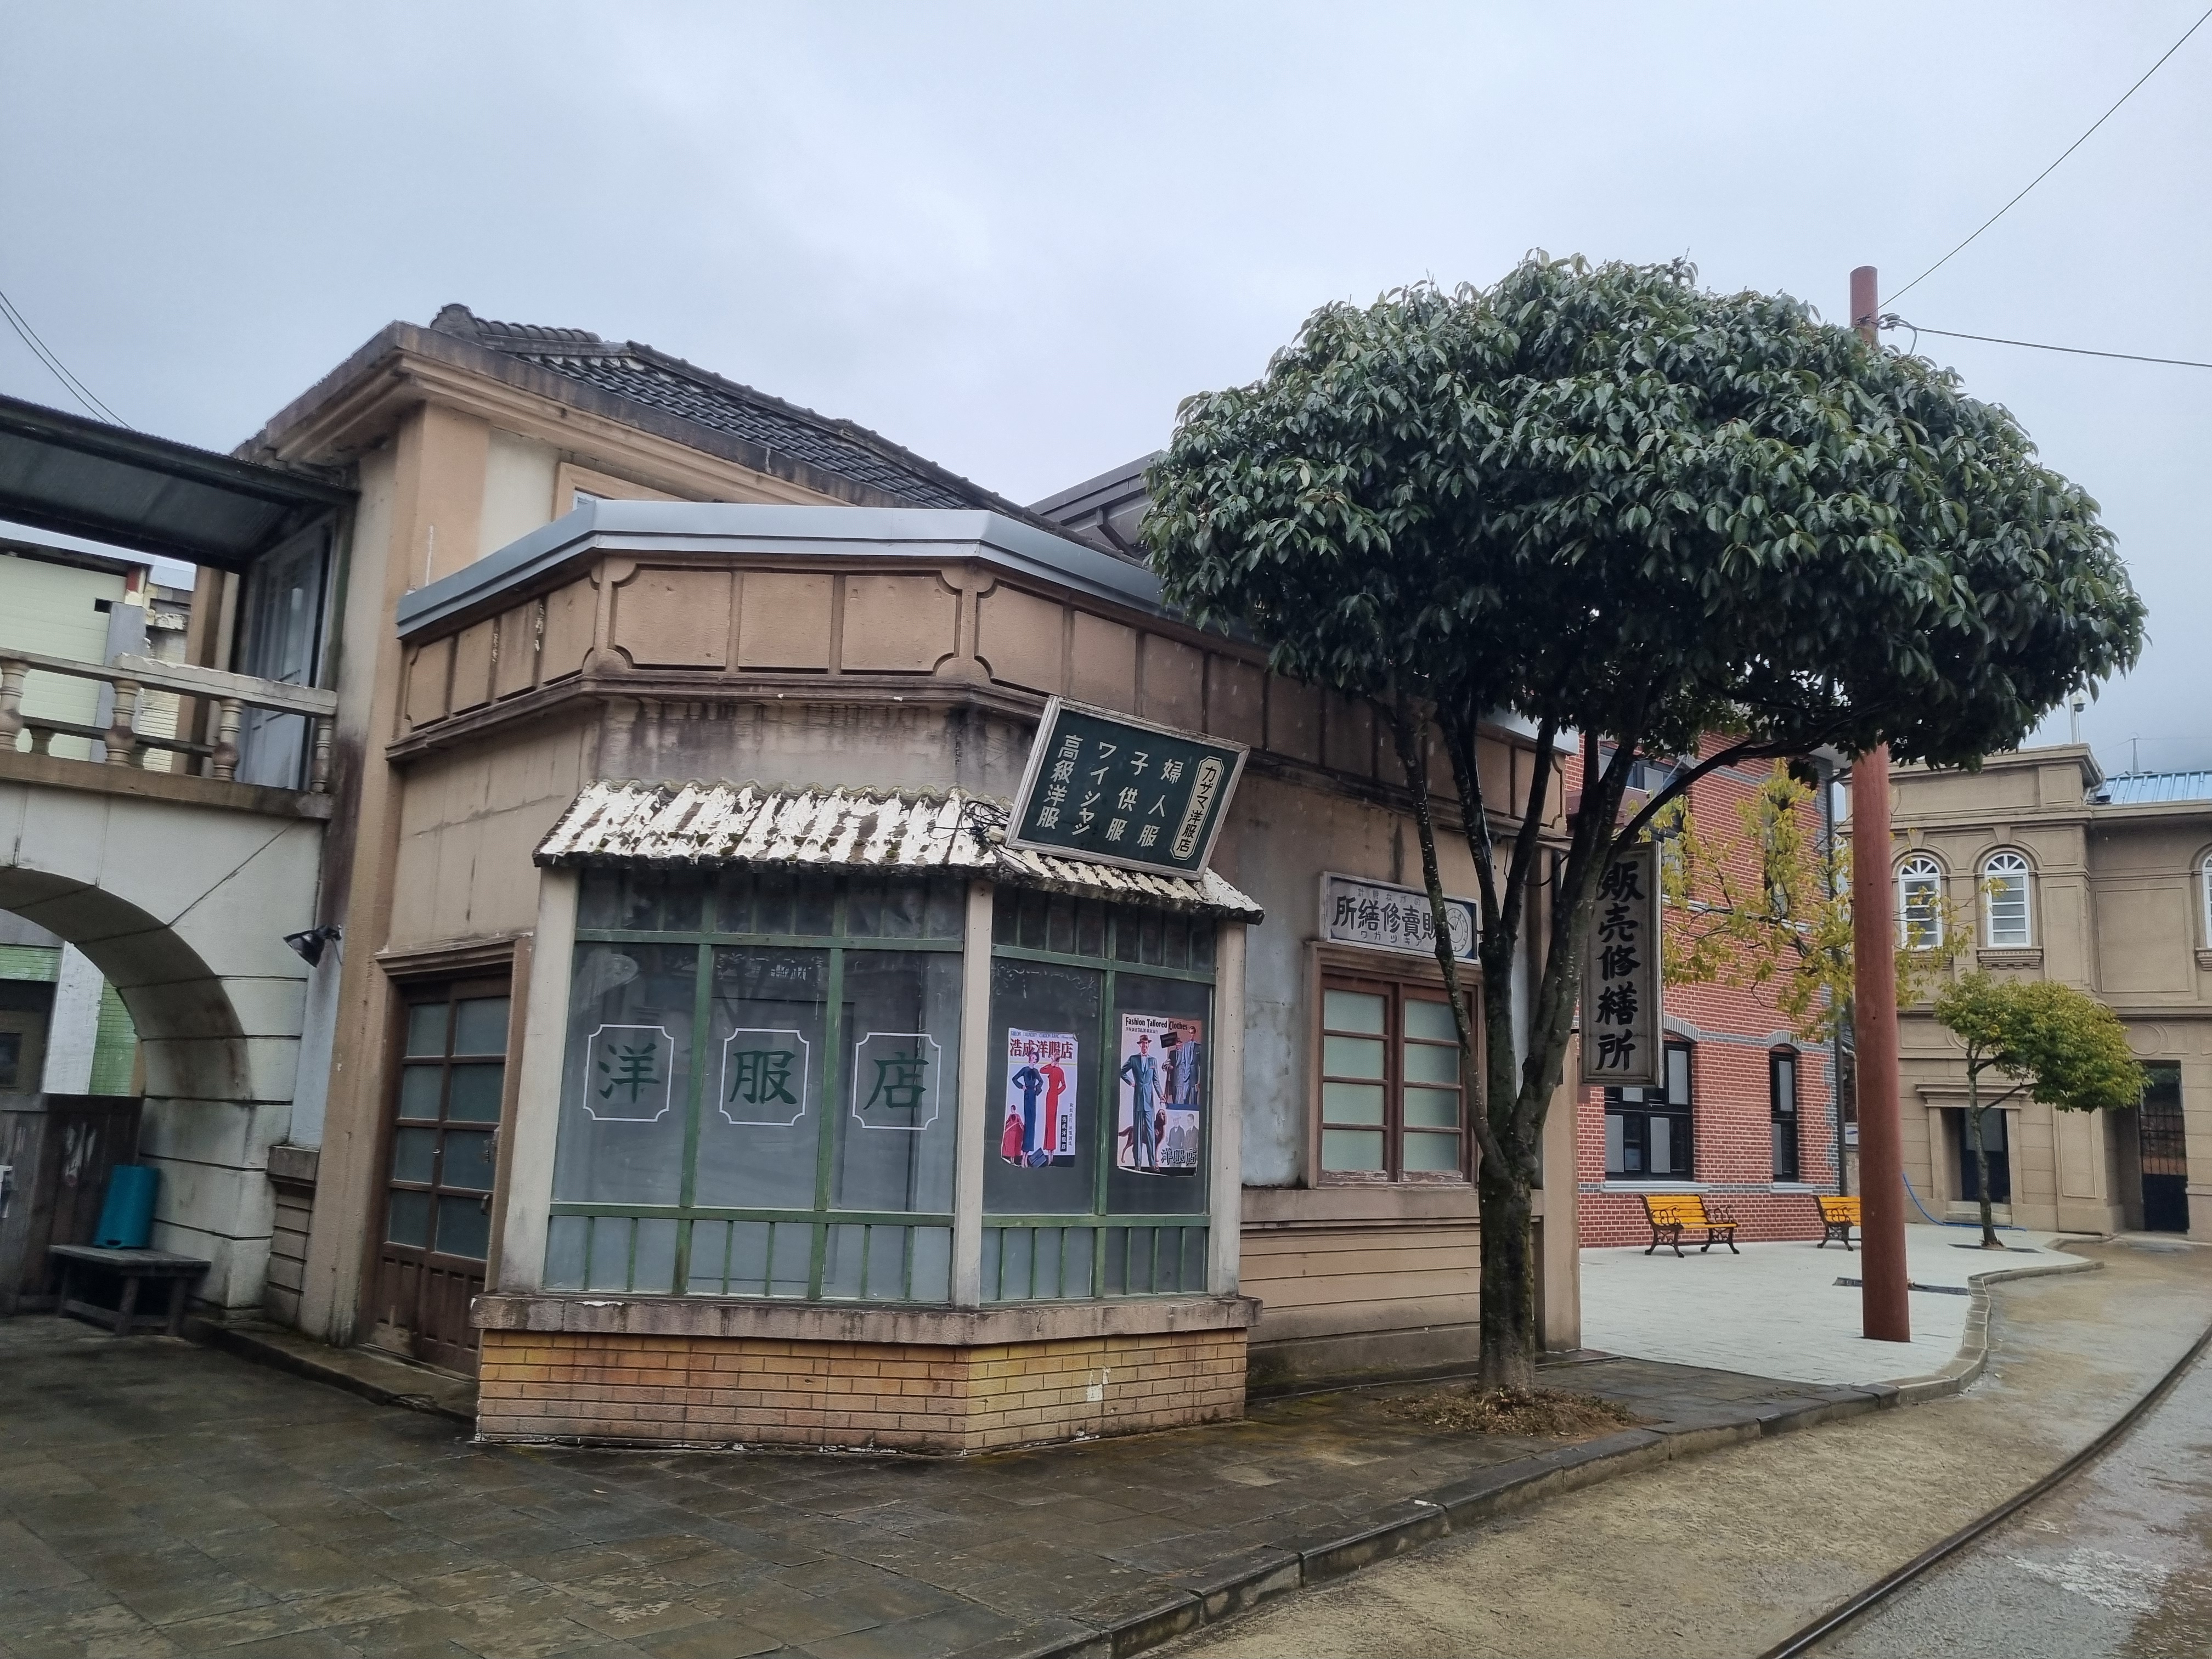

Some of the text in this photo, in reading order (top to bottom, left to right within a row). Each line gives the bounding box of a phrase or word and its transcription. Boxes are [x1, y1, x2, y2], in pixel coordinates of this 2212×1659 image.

[1036, 734, 1084, 830] 高級洋服
[1105, 751, 1149, 842] 子供服
[1137, 759, 1184, 848] 婦人服
[1176, 766, 1217, 853] カザマ洋服店
[1595, 860, 1645, 1071] 販売修繕所
[1125, 1017, 1146, 1026] Fashion
[1169, 1021, 1188, 1030] Clothes
[1160, 1147, 1197, 1166] 洋服店
